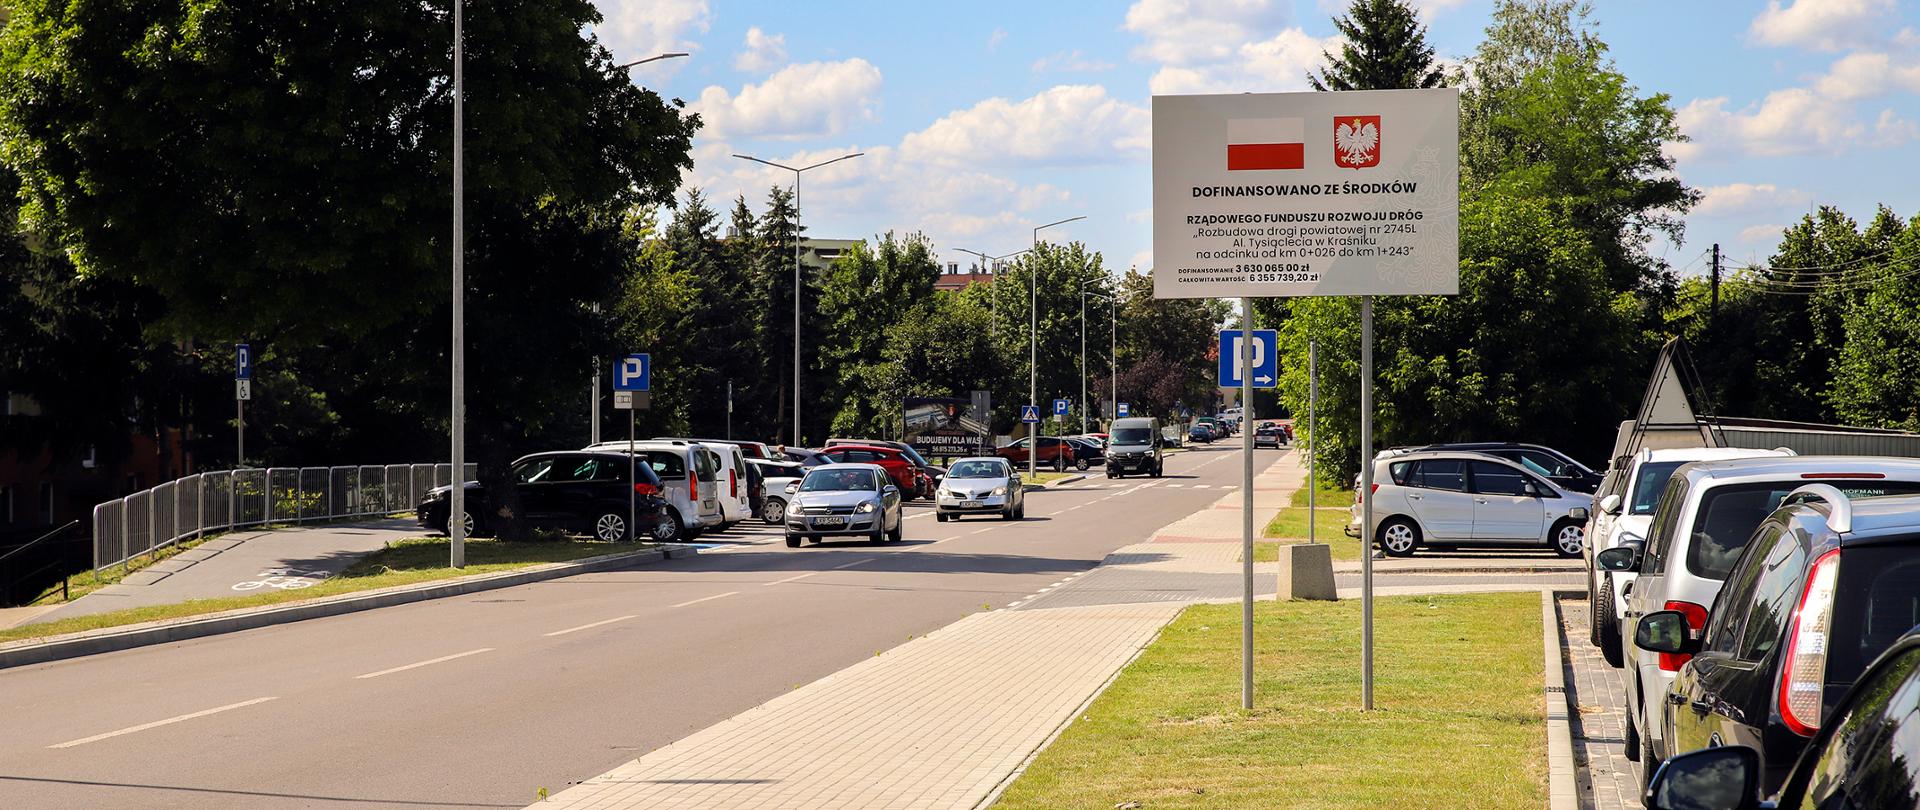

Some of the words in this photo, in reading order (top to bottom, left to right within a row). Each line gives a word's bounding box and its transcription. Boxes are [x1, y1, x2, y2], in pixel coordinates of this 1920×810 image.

[1192, 185, 1321, 198] DOFINANSOWANO
[1324, 184, 1340, 195] ZE
[1343, 180, 1417, 195] ŚRODKÓW
[1187, 214, 1262, 226] RZĄDOWEGO
[1264, 212, 1325, 223] FUNDUSZU
[1328, 212, 1387, 221] ROZWOJU
[1389, 209, 1424, 221] DRÓG
[1192, 227, 1264, 239] „Rozbudowa
[1267, 226, 1298, 238] drogi
[1300, 225, 1367, 237] powiatowej
[1369, 226, 1382, 234] nr
[1384, 224, 1417, 234] 2745L
[1233, 238, 1246, 248] Al.
[1249, 237, 1313, 249] Tysiąclecia
[1327, 235, 1377, 246] Kraśniku
[1196, 251, 1211, 259] na
[1213, 249, 1259, 259] odcinku
[1261, 248, 1277, 258] od
[1279, 248, 1297, 258] km
[1299, 247, 1336, 258] 0+026
[1338, 247, 1354, 257] do
[1356, 246, 1375, 257] km
[1235, 264, 1242, 273] 3
[1243, 264, 1263, 273] 630
[1264, 264, 1284, 272] 065
[1286, 263, 1299, 272] 00
[1300, 263, 1310, 272] zł
[1249, 273, 1256, 282] 6
[1257, 273, 1276, 282] 355
[1277, 273, 1308, 283] 739,20
[1310, 273, 1318, 281] zł
[240, 348, 247, 375] P
[1233, 336, 1265, 381] P
[622, 357, 642, 386] P
[1057, 401, 1066, 413] P
[916, 435, 952, 444] BUDUJEMY
[952, 436, 965, 444] DLA
